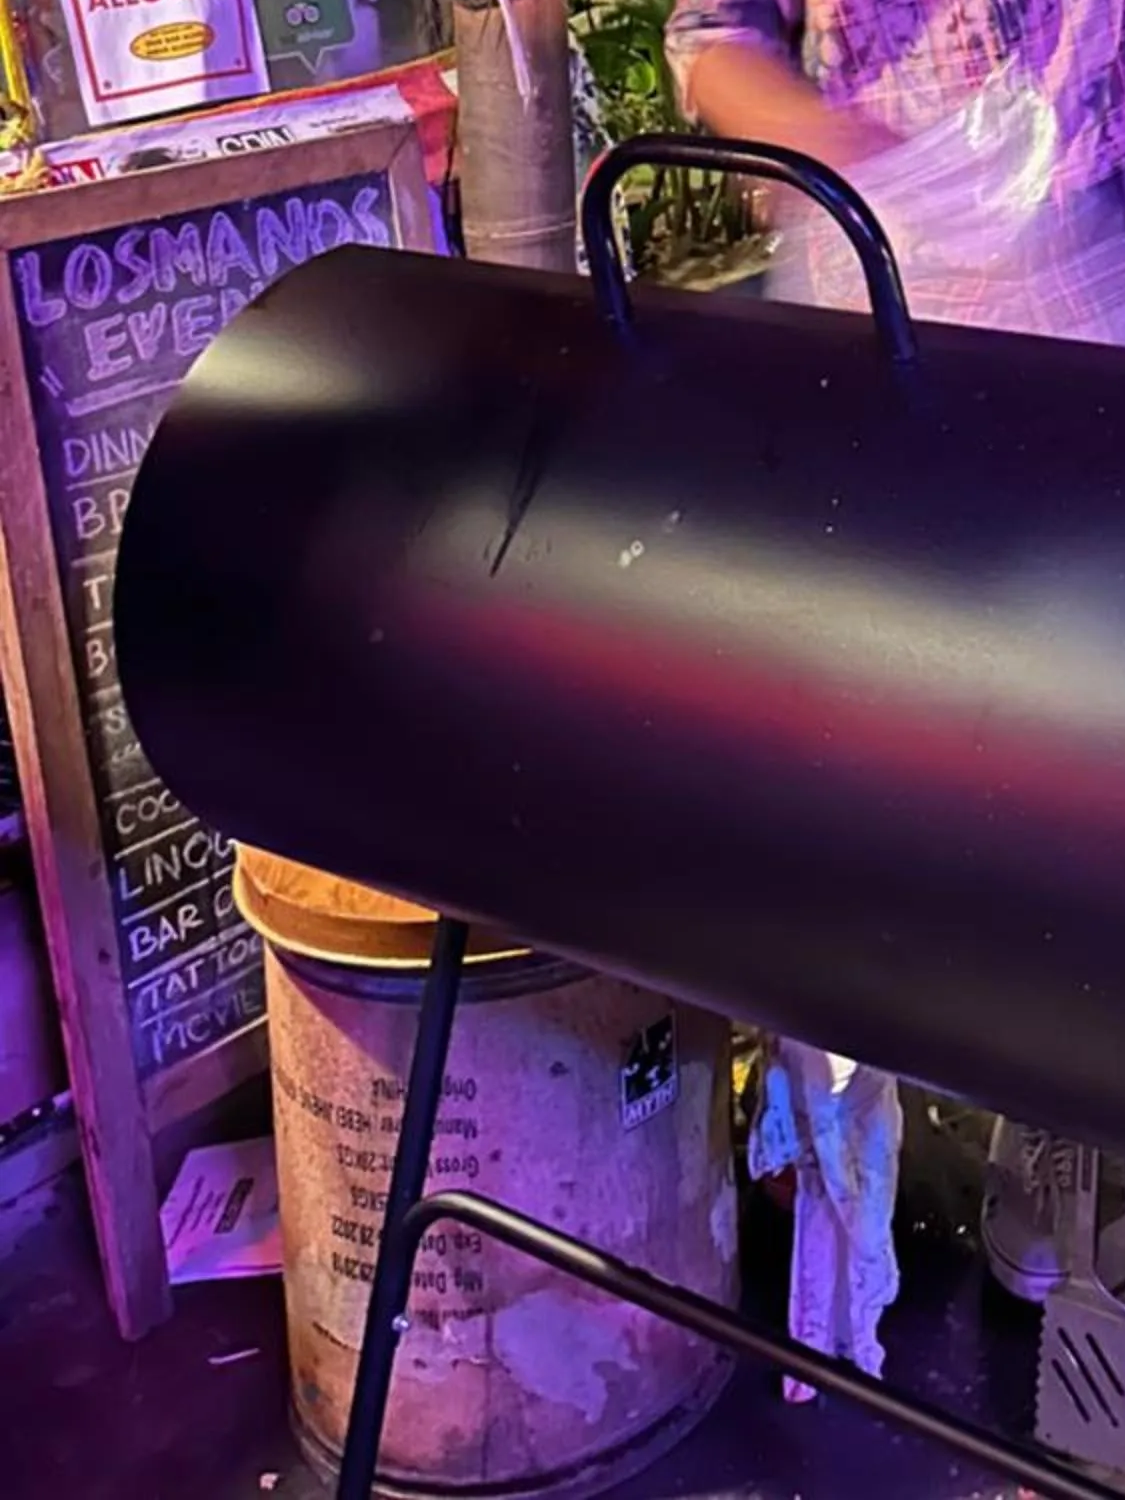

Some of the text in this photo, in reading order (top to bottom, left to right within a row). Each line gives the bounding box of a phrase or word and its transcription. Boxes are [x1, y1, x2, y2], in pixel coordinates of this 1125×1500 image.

[128, 903, 204, 963] BAR
[435, 1155, 480, 1179] Gross
[420, 1233, 447, 1257] Dat
